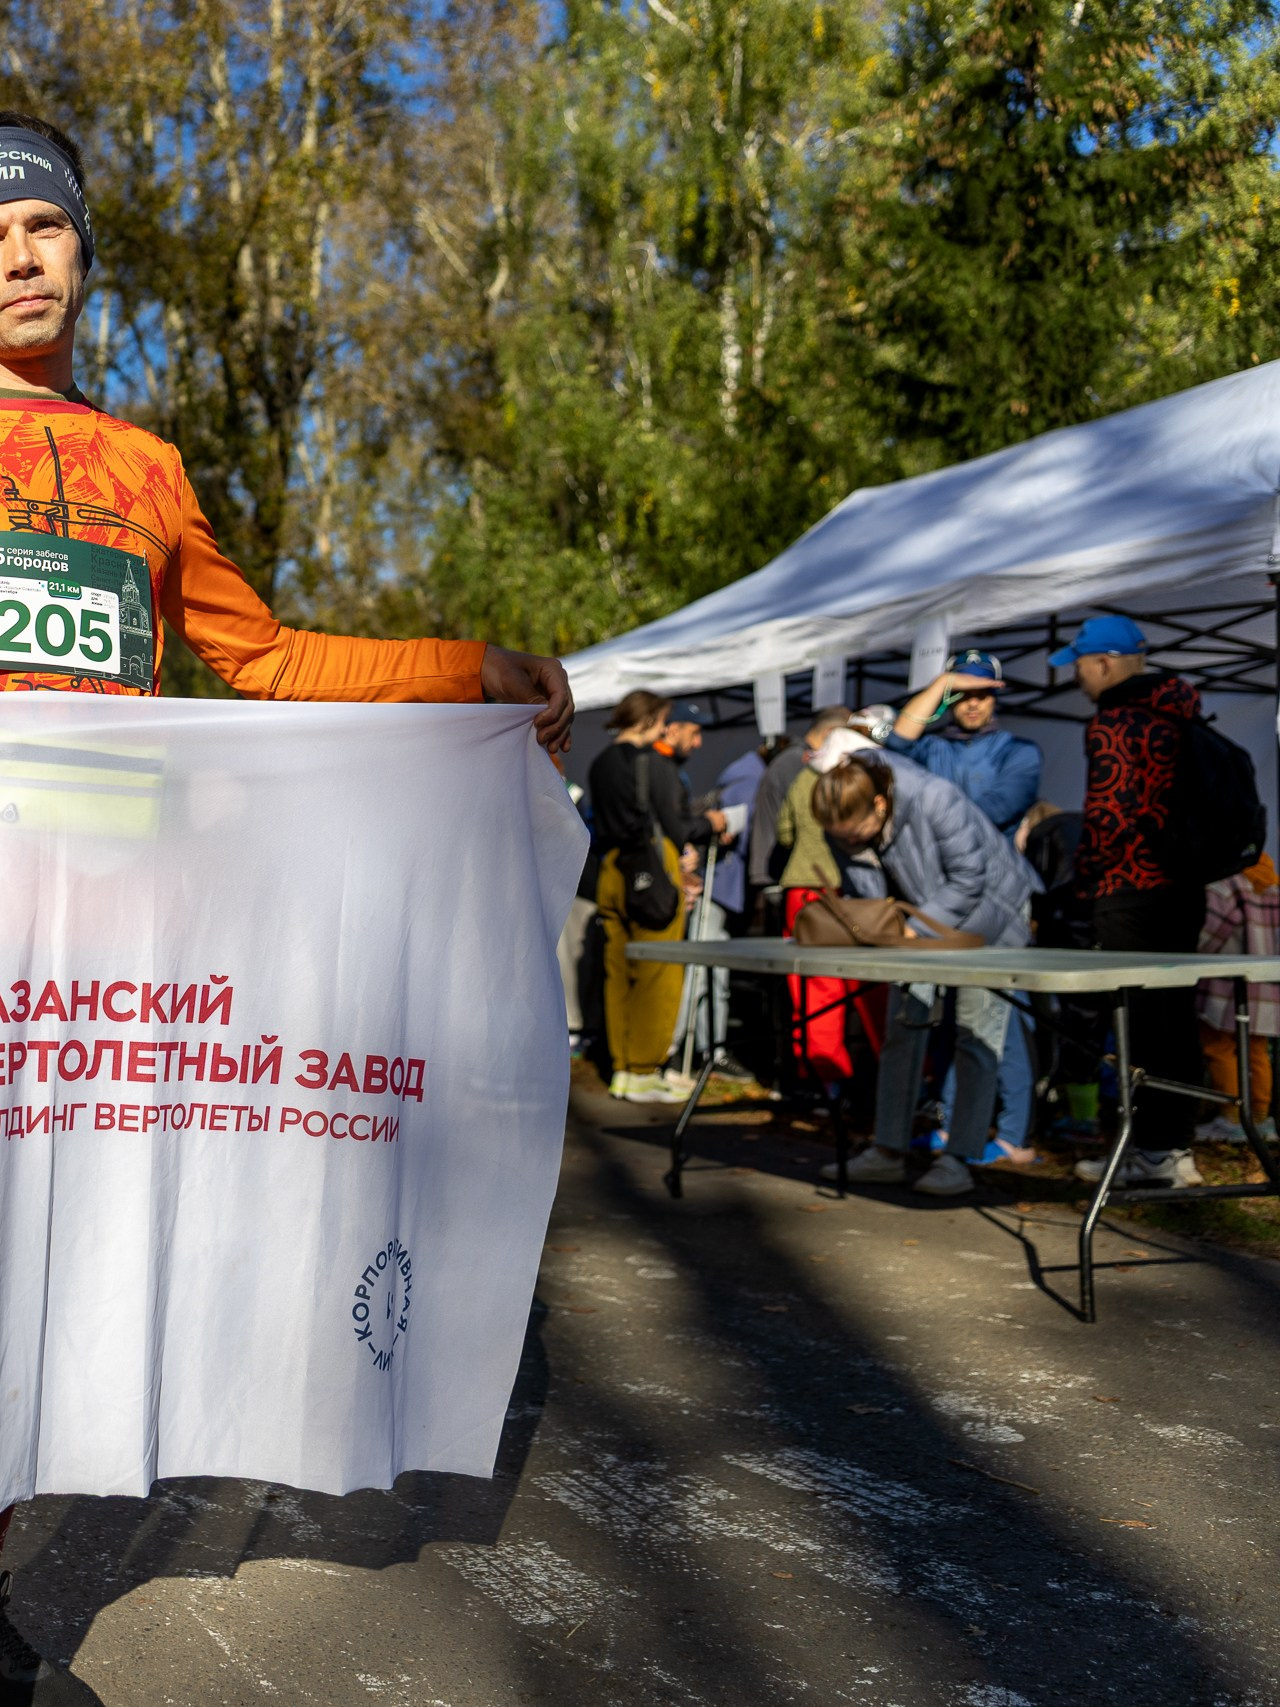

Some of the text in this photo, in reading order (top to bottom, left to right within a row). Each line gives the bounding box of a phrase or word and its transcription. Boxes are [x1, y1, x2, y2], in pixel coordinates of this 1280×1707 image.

[6, 547, 69, 561] серия забегов
[6, 555, 69, 573] городов
[48, 582, 65, 593] 21,1
[294, 1048, 426, 1103] ЗАВОД
[94, 1102, 269, 1133] ВЕРТОЛЕТЫ
[279, 1107, 400, 1143] РОССИИ
